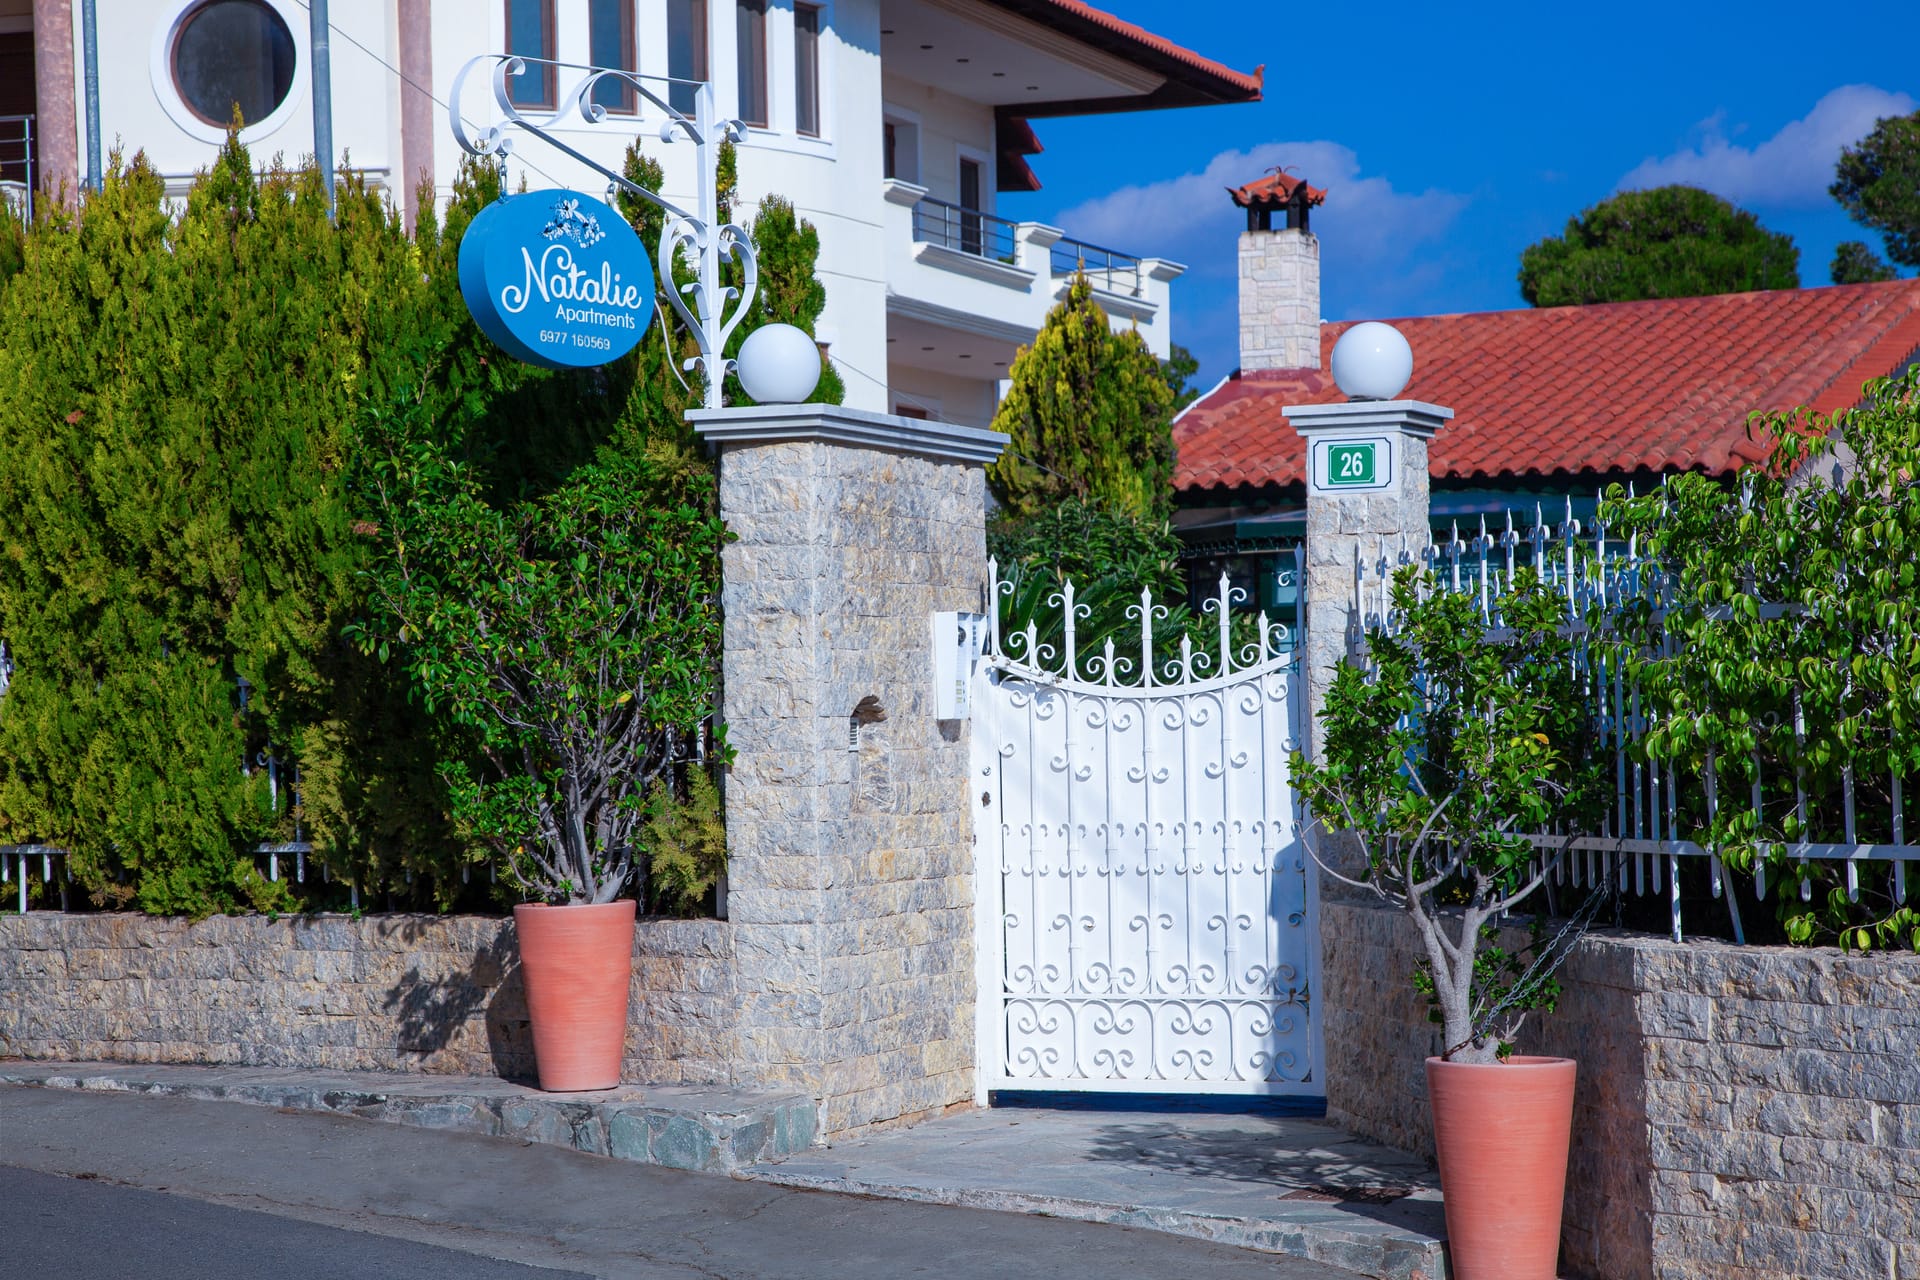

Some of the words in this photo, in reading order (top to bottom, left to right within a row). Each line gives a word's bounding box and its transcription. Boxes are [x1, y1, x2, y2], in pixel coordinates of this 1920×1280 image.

[501, 244, 642, 313] Natalie
[555, 303, 636, 329] Apartments
[539, 330, 568, 344] 6977
[571, 333, 611, 350] 160569
[1340, 452, 1363, 477] 26
